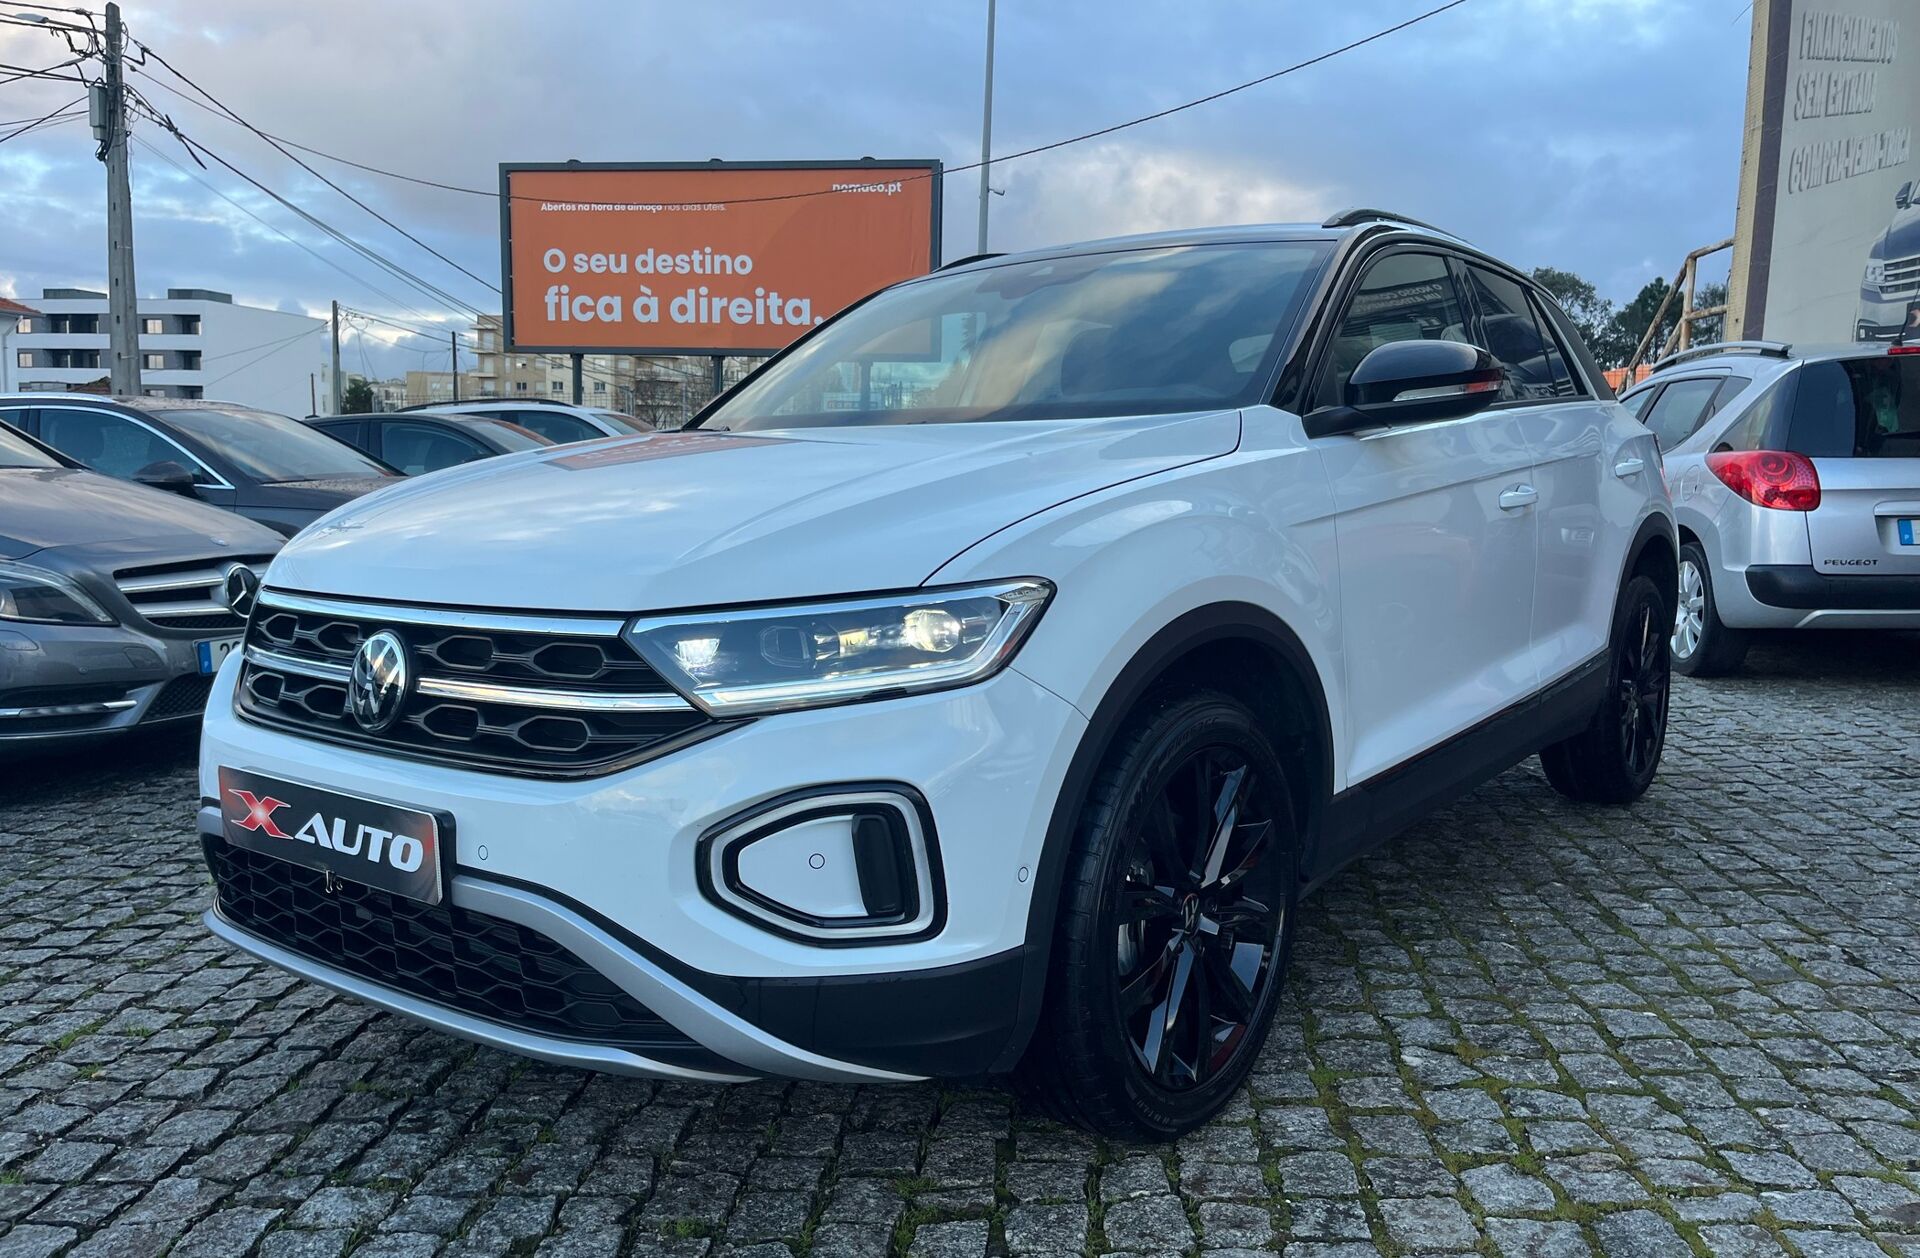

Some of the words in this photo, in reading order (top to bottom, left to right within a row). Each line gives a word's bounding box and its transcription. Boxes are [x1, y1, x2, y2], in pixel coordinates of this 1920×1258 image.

[1800, 10, 1902, 64] FINANCIAMENTOS
[1793, 71, 1823, 121] SEM
[1824, 71, 1877, 118] ENTRADA
[541, 202, 576, 211] Abertos
[543, 248, 566, 273] O
[573, 253, 627, 274] seu
[634, 247, 753, 274] destino
[545, 284, 622, 322] fica
[632, 284, 659, 322] à
[669, 286, 824, 326] direita.
[293, 812, 424, 873] AUTO
